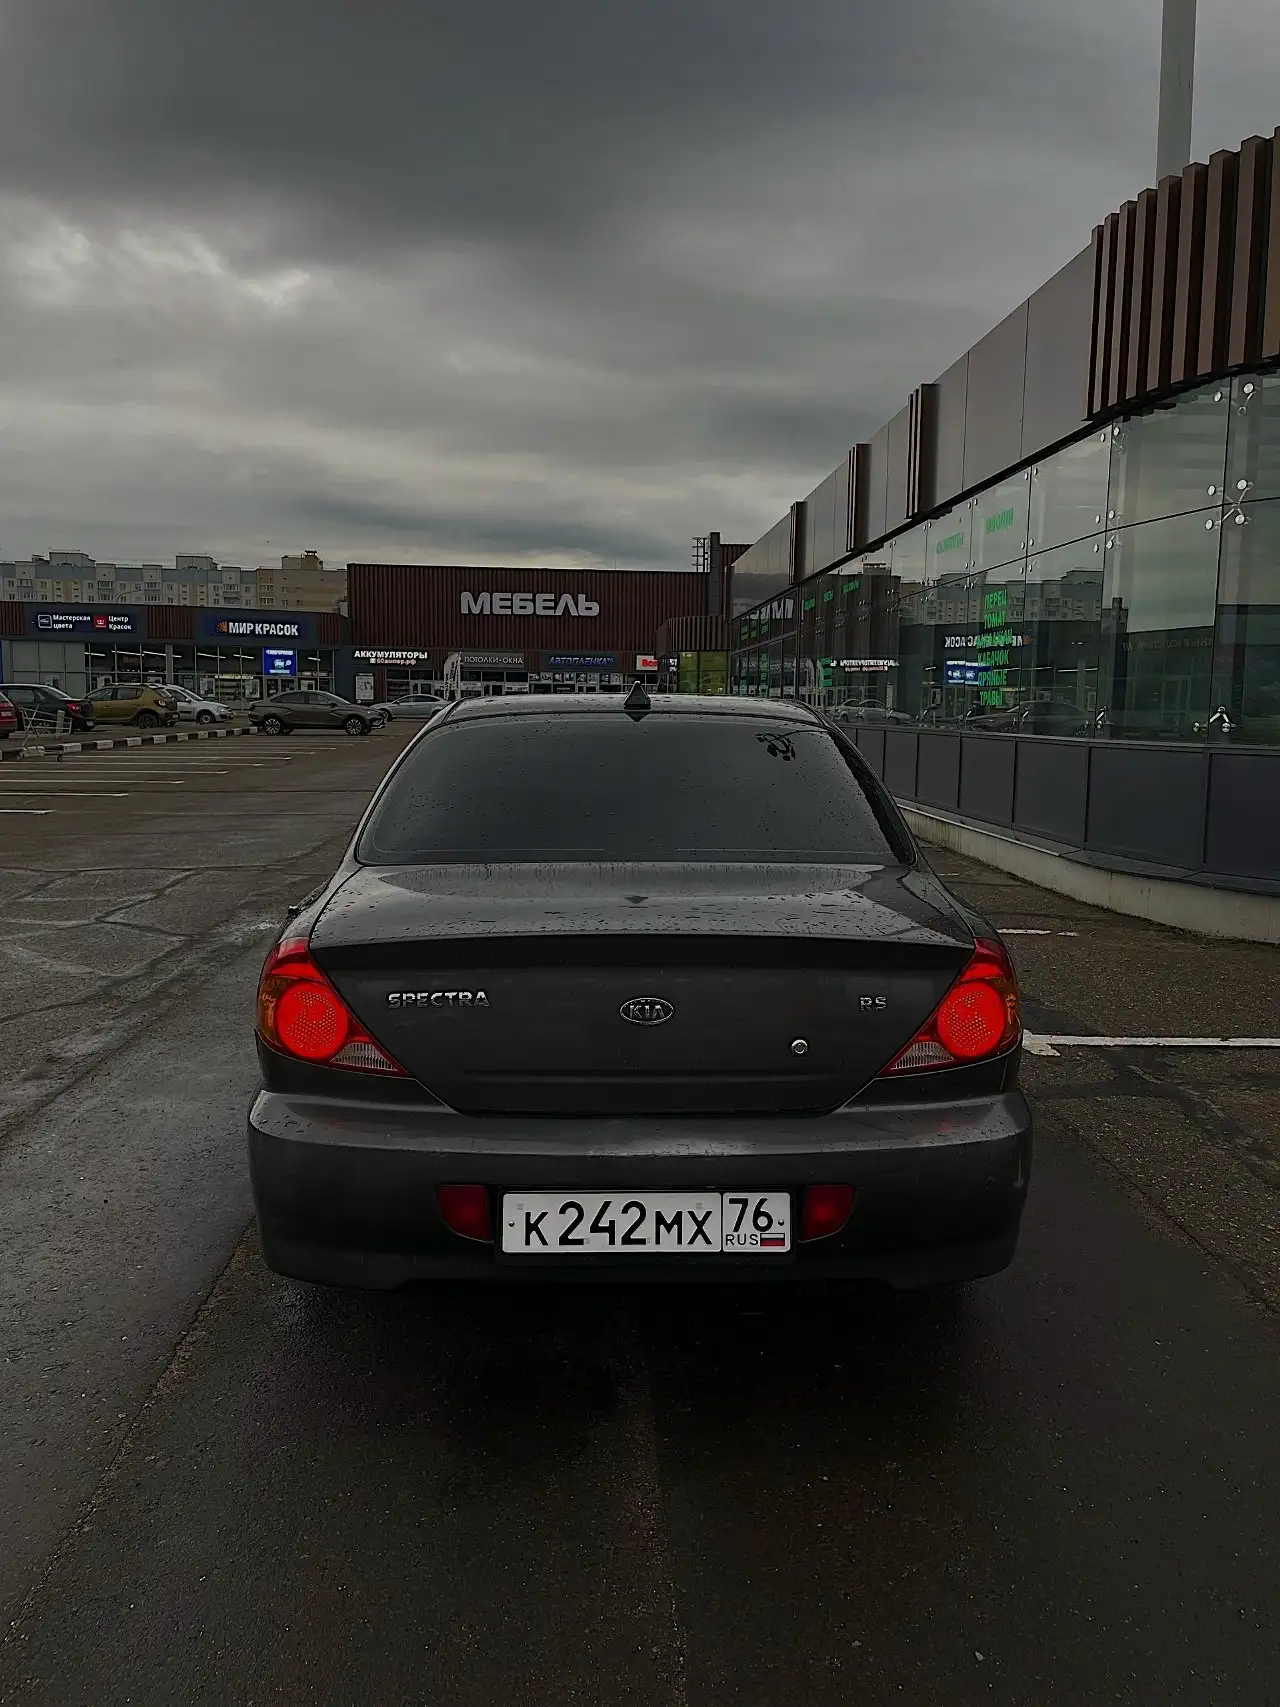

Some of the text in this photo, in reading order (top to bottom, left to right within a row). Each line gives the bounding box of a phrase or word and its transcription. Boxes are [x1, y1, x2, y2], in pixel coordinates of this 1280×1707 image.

[460, 591, 600, 617] МЕБЕЛЬ
[52, 614, 91, 622] Мастерская
[108, 615, 129, 623] Центр
[228, 622, 299, 636] МИР КРАСОК
[353, 650, 428, 659] АККУМУЛЯТОРЫ
[464, 656, 524, 664] ПОТОЛКИ ОКНА
[387, 991, 491, 1009] SPECTRA
[859, 996, 887, 1011] RS
[629, 1004, 665, 1019] KIA
[524, 1197, 774, 1246] К242МХ 76
[725, 1234, 759, 1246] RUS
